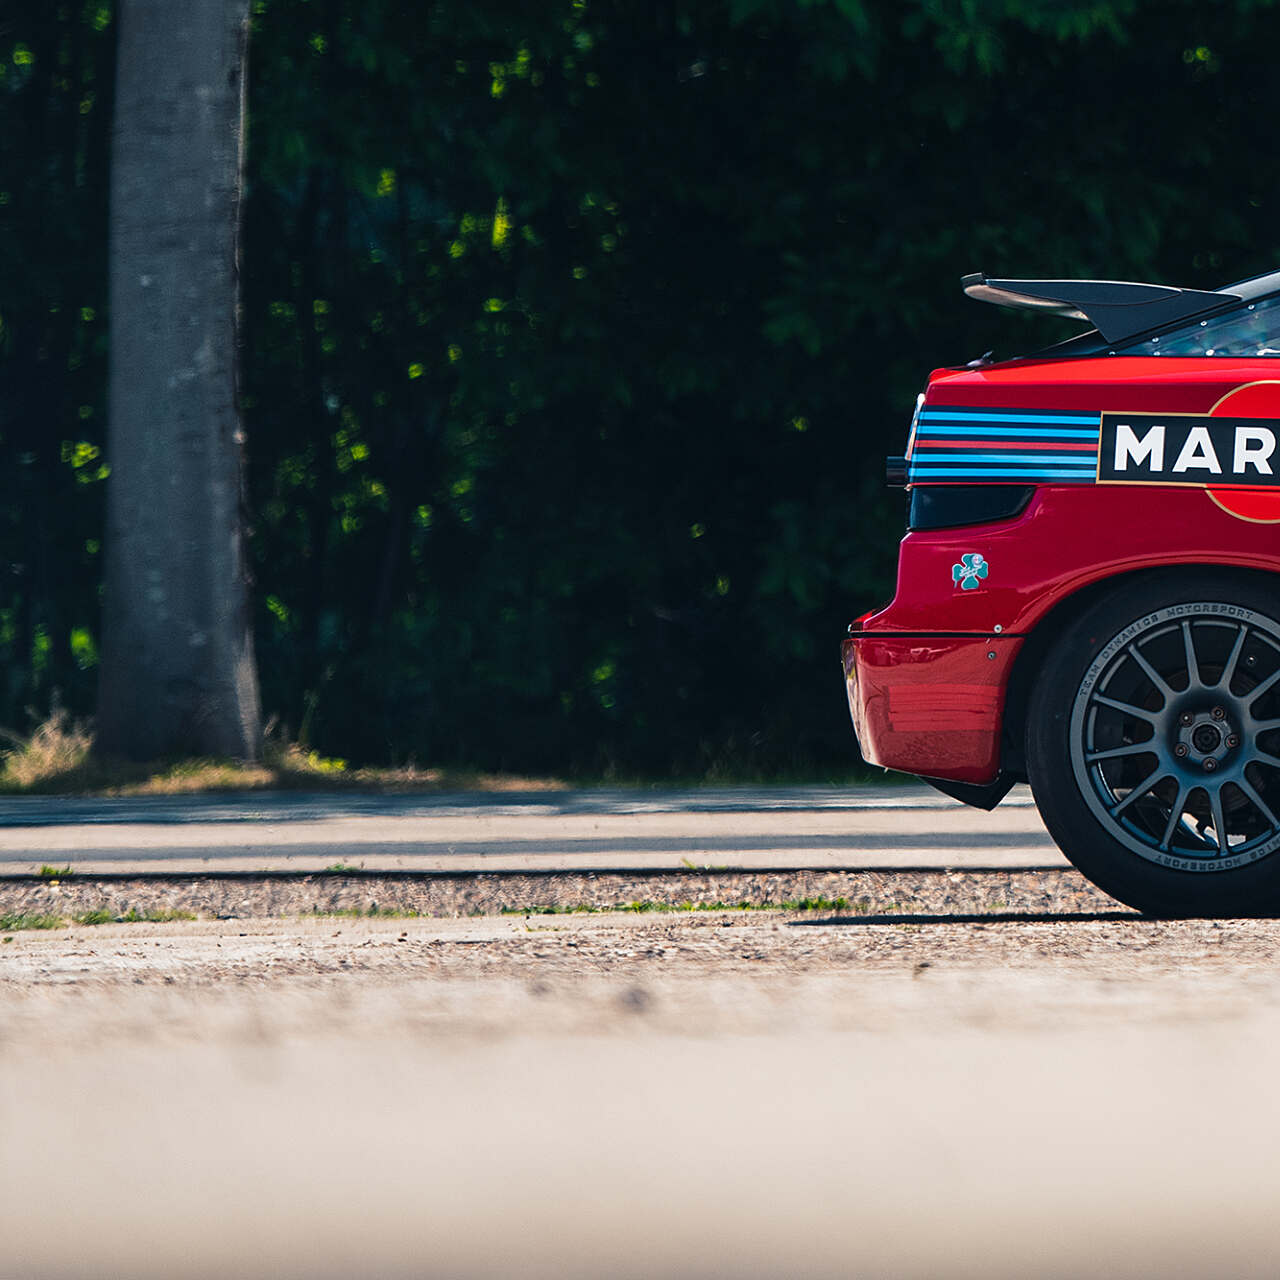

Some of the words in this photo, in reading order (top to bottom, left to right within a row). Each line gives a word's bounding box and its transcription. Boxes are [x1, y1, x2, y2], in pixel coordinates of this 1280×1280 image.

[1080, 665, 1100, 696] TEAM
[1102, 614, 1159, 660] DYNAMICS
[1167, 604, 1253, 620] MOTORSPORT
[1155, 855, 1241, 870] MOTORSPORT
